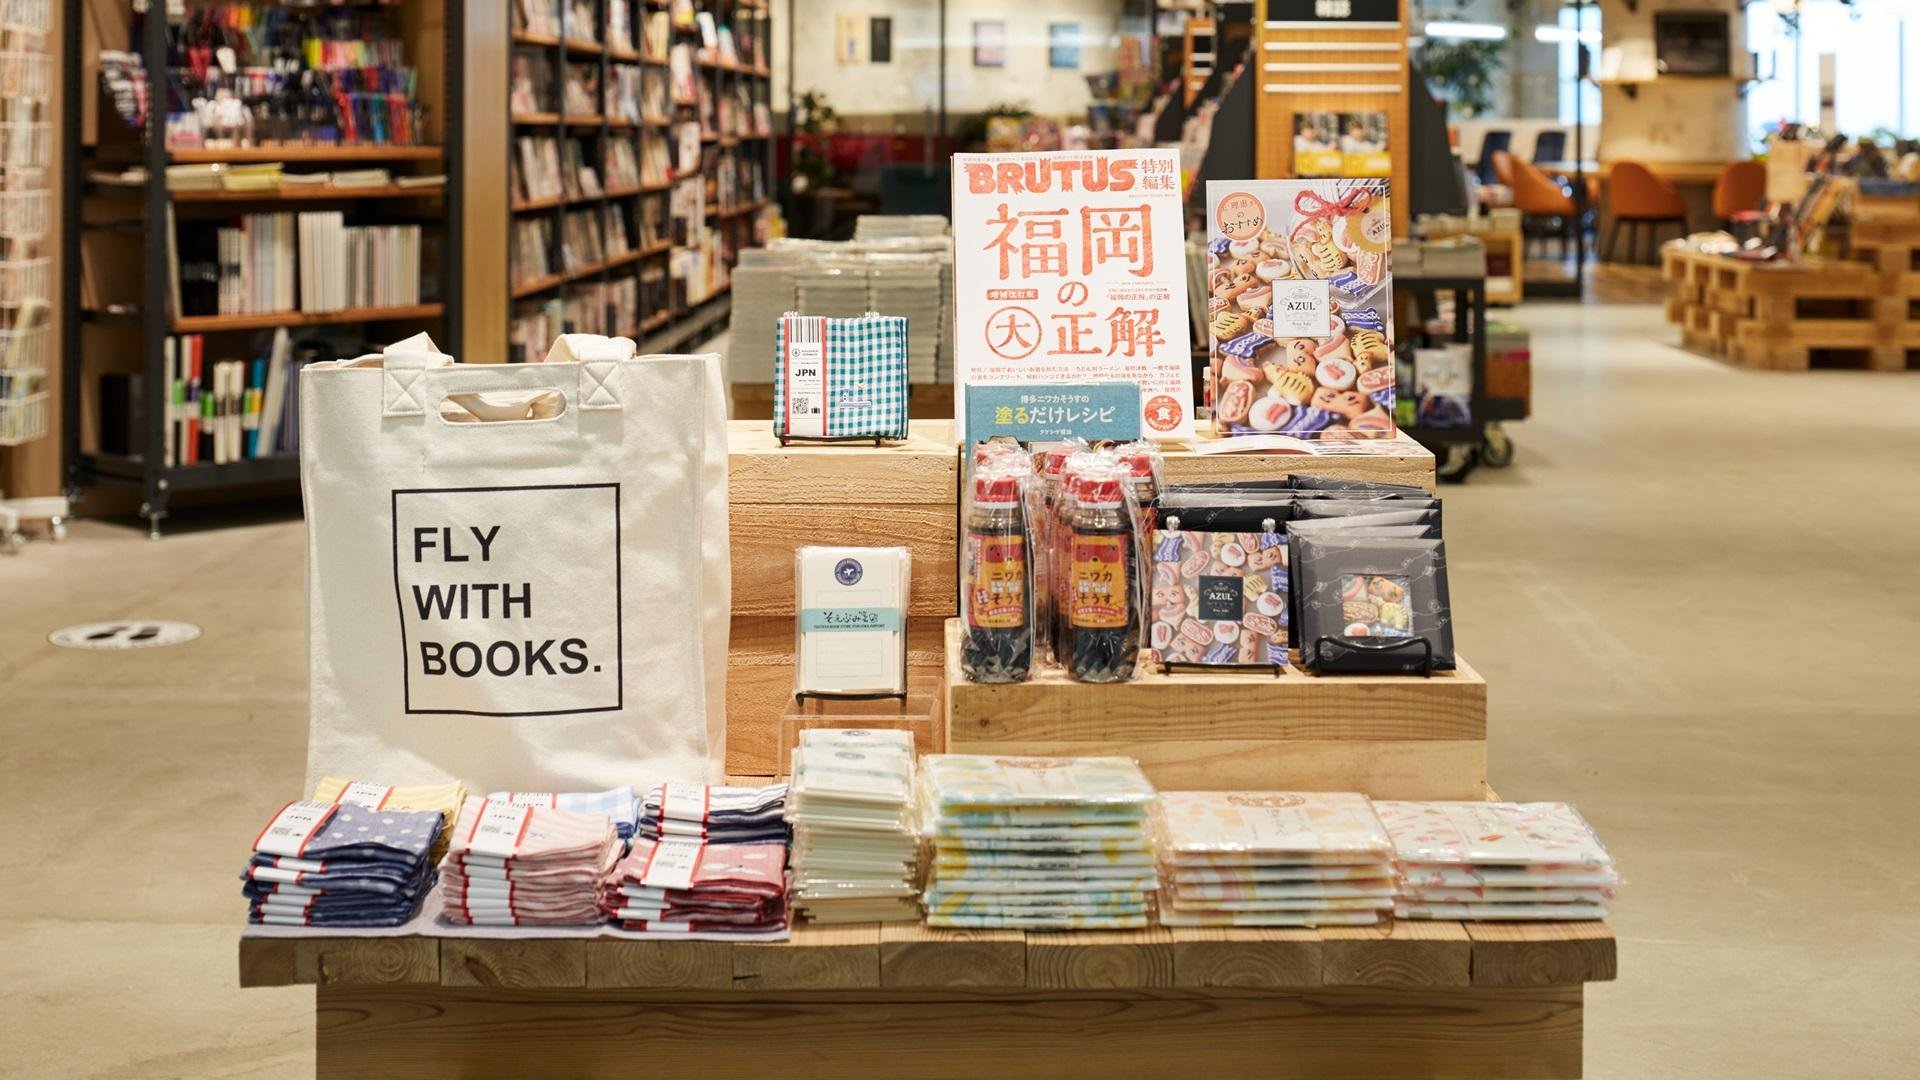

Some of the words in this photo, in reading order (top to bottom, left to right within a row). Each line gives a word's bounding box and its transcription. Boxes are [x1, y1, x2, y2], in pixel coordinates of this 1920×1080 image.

[1141, 159, 1173, 174] 特別
[964, 156, 1138, 194] BRUTUS
[1142, 175, 1176, 190] 編集
[983, 203, 1153, 280] 福岡
[1058, 281, 1088, 306] の
[1287, 302, 1316, 311] AZUL
[795, 369, 816, 377] JPN
[1021, 395, 1089, 404] 博多ニワカそうすの
[995, 406, 1116, 425] 塗るだけレシピ
[414, 526, 500, 562] FLY
[1079, 571, 1112, 581] ニワカ
[412, 583, 531, 620] WITH
[1079, 593, 1113, 605] そうす
[1209, 592, 1233, 601] AZUL
[420, 638, 601, 677] BOOKS.
